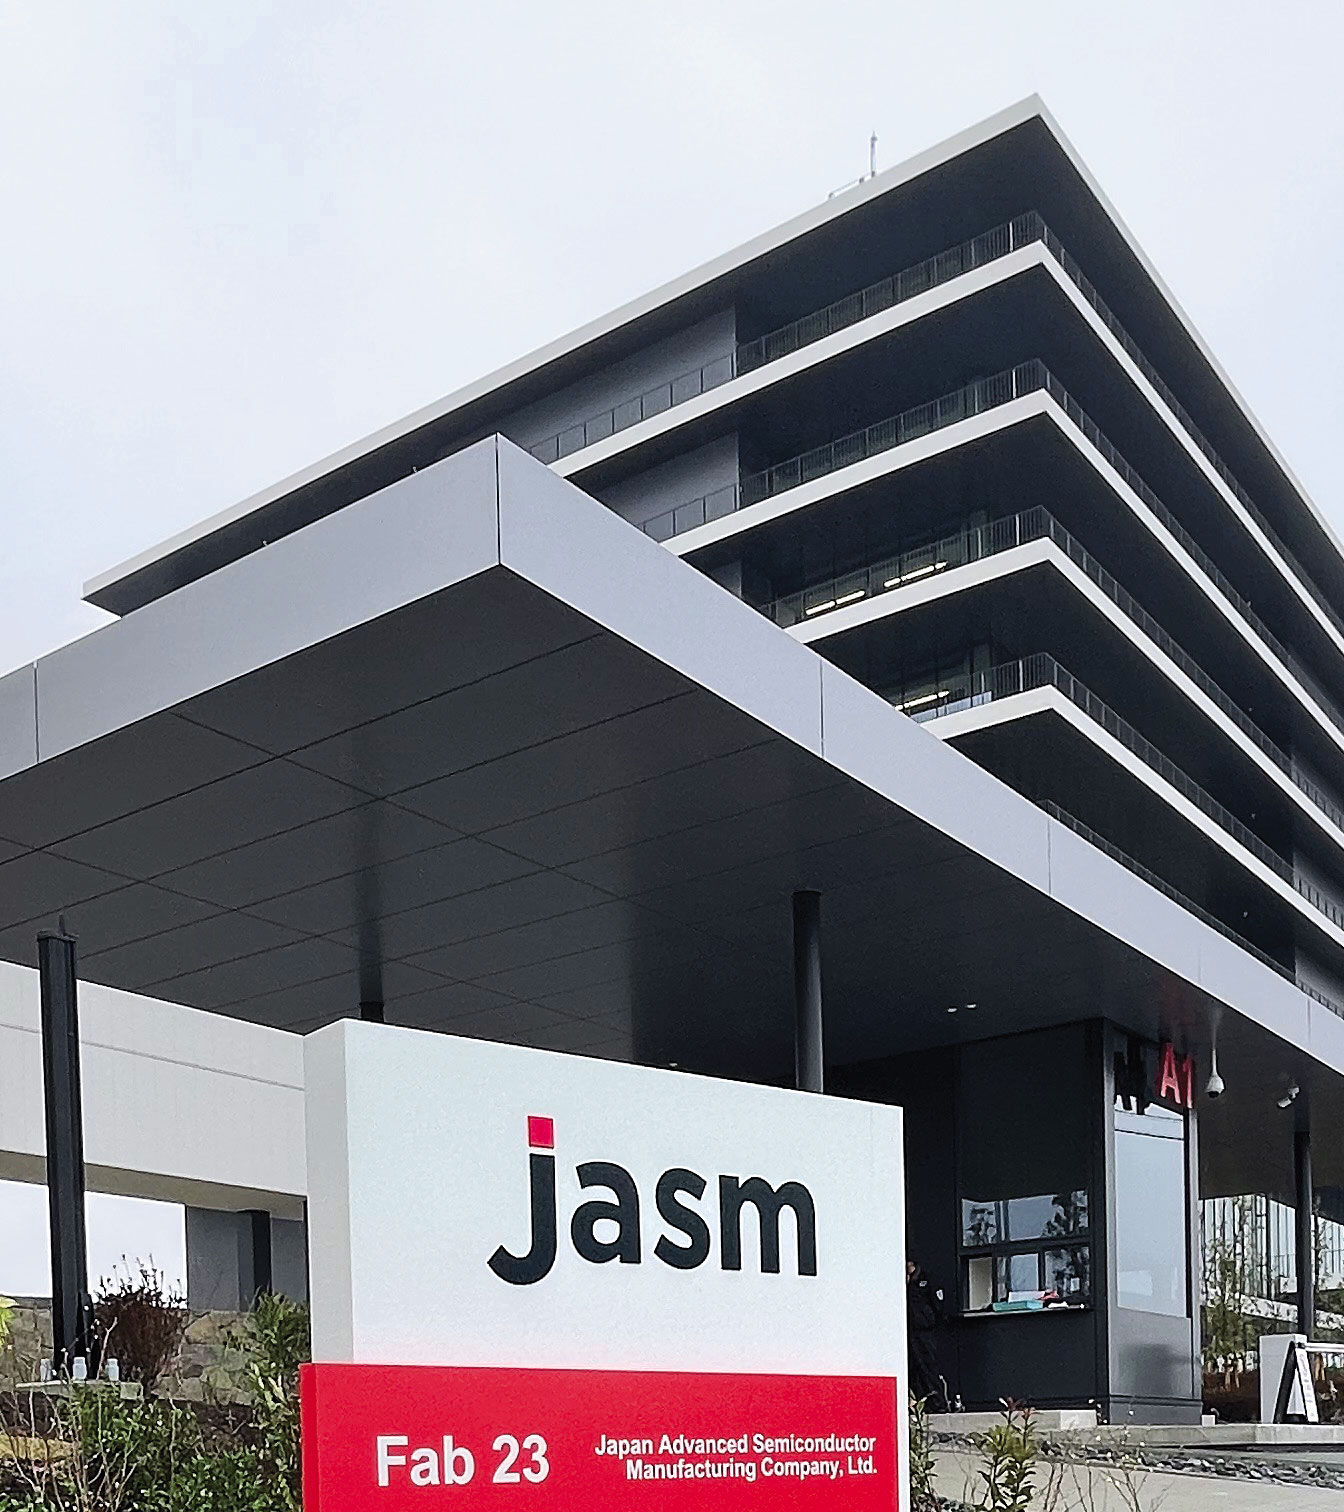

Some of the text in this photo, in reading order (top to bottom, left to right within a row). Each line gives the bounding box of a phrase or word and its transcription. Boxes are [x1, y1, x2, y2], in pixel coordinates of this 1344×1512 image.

[1160, 1042, 1193, 1109] A1
[487, 1115, 818, 1286] jasm
[376, 1434, 550, 1487] Fab 23
[594, 1433, 876, 1460] Japan Advanced Semiconductor
[626, 1455, 878, 1483] Manufacturing Company, Ltd.
